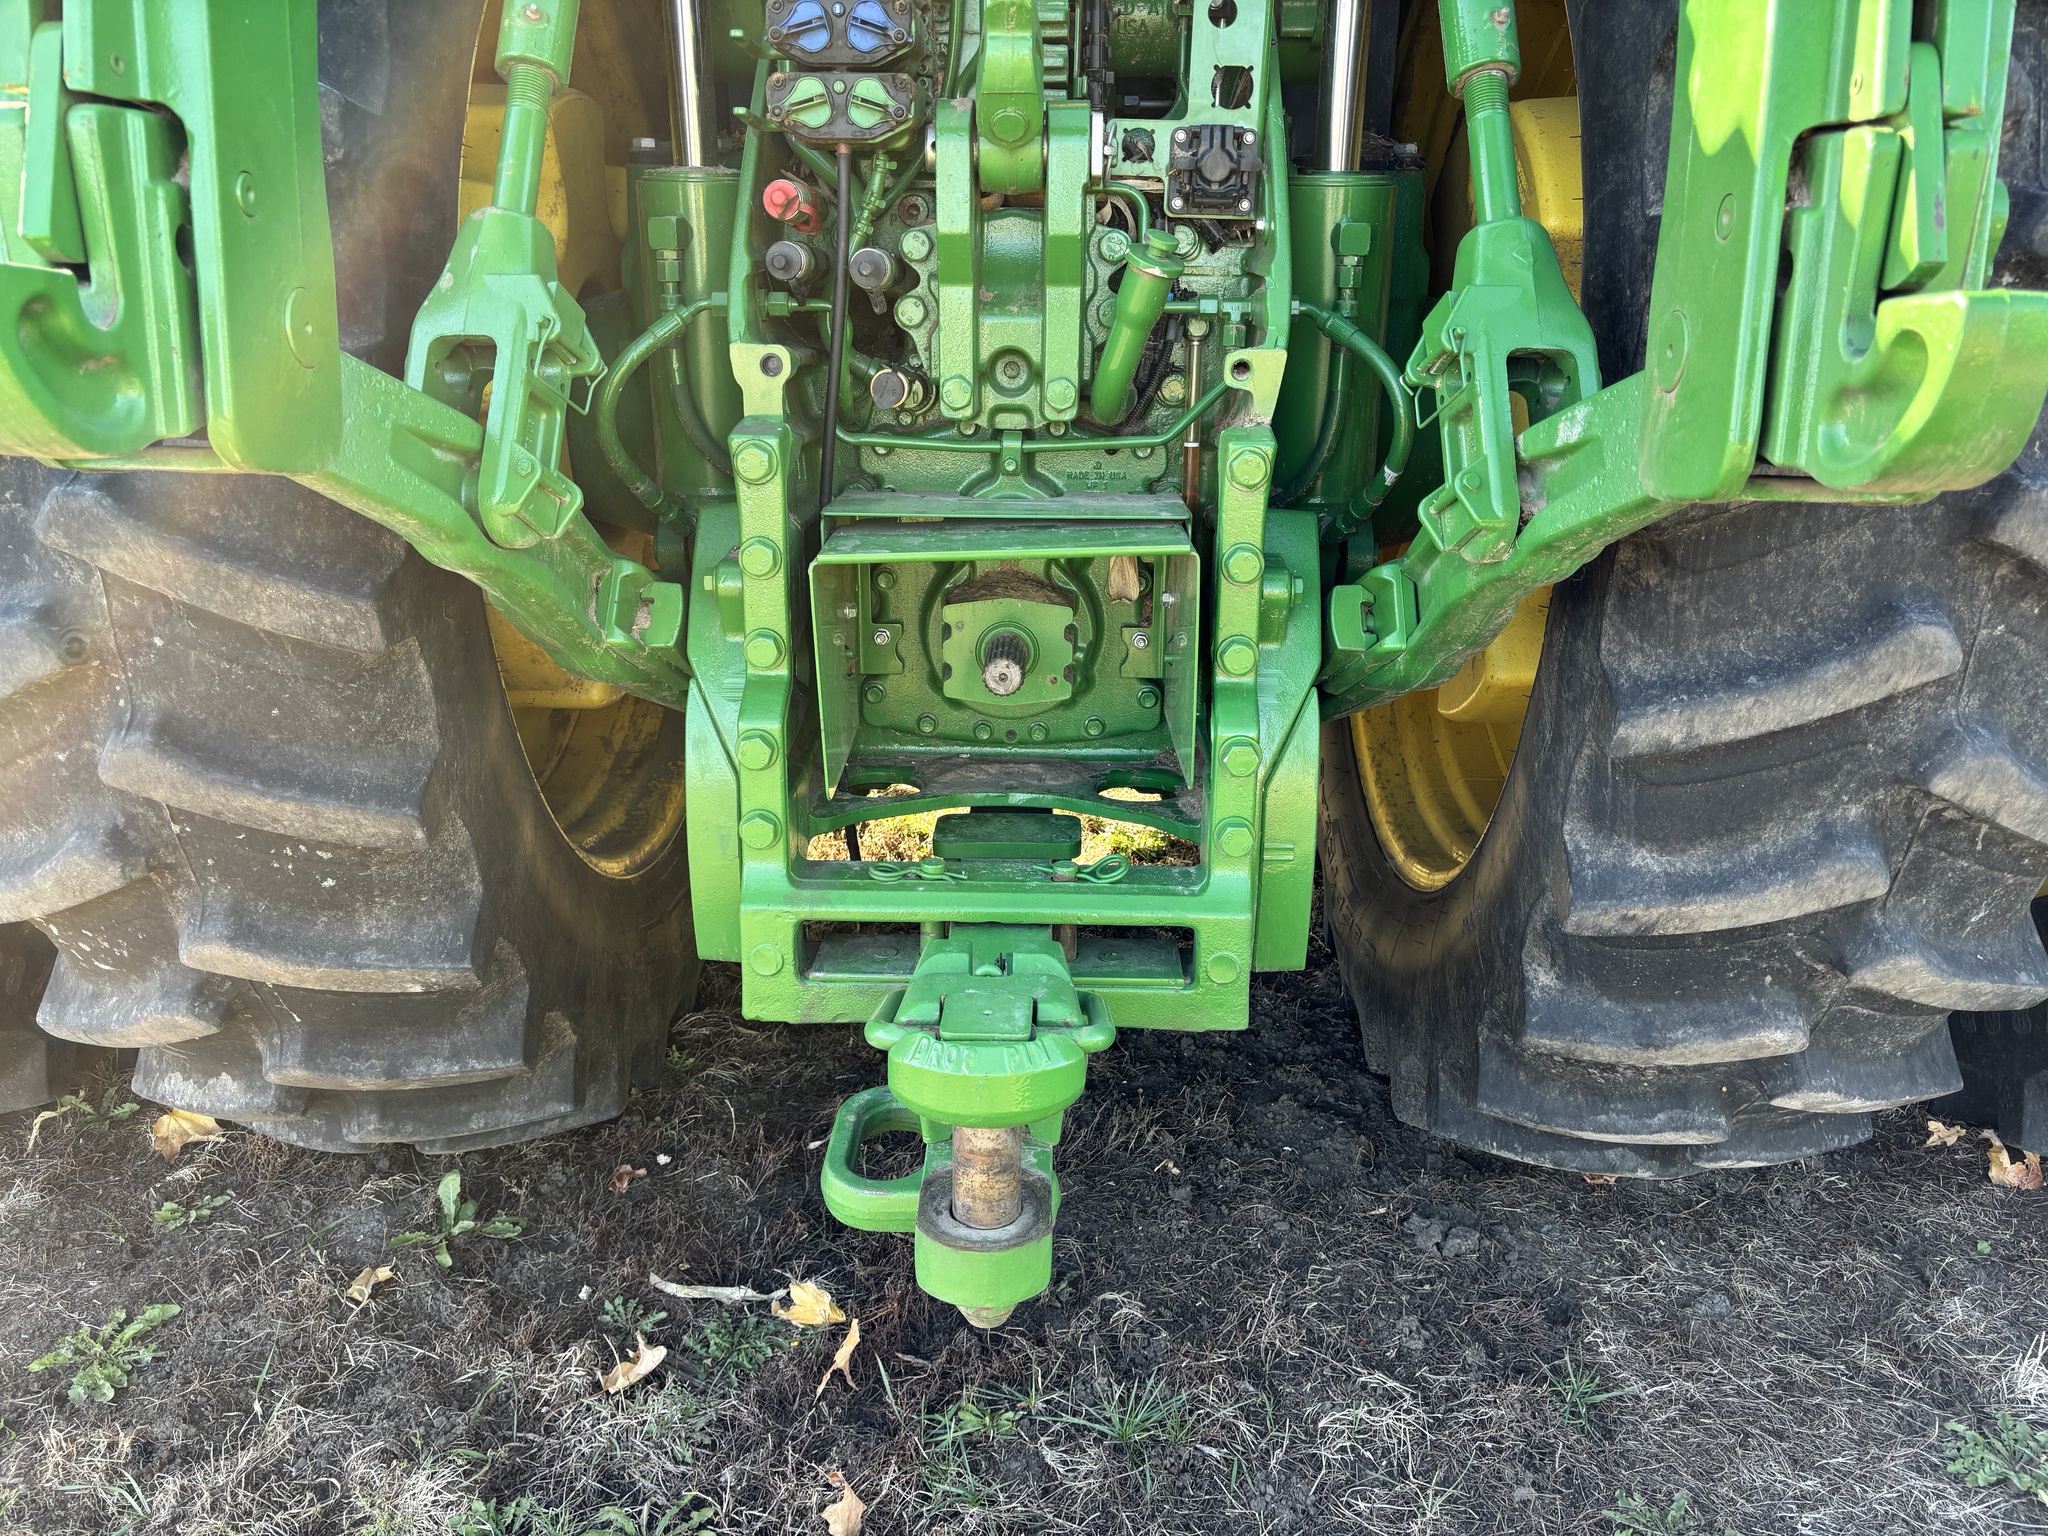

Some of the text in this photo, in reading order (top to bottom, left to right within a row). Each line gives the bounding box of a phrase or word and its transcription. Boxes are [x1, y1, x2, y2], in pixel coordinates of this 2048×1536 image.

[1116, 18, 1149, 35] USA
[1066, 470, 1128, 480] MADE IN USA
[1003, 1037, 1051, 1076] PIN
